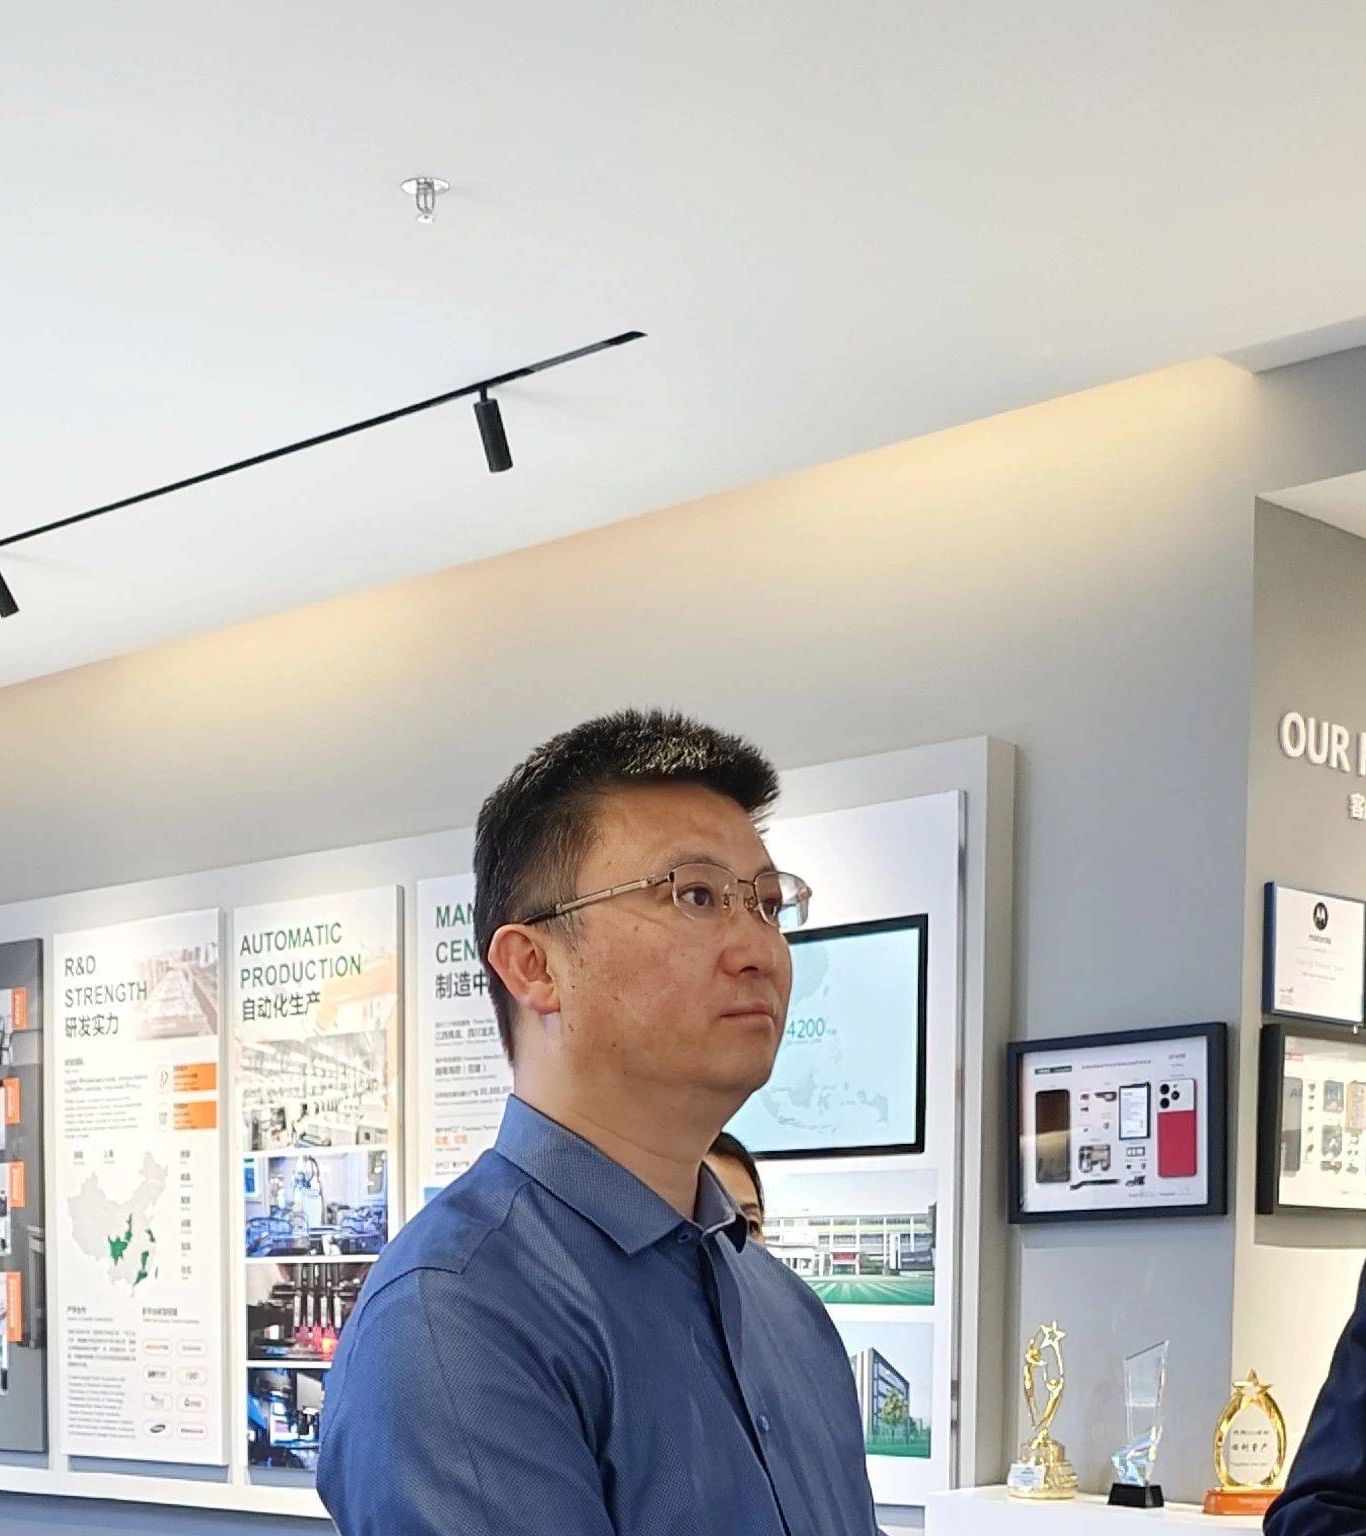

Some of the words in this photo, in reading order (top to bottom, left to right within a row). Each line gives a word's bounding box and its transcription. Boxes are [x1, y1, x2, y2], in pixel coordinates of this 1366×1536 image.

[1280, 711, 1351, 772] OUR
[240, 922, 342, 956] AUTOMATIC
[65, 955, 96, 977] R&D
[240, 954, 361, 989] PRODUCTION
[65, 981, 148, 1008] STRENGTH
[435, 969, 490, 999] 制造中
[242, 991, 321, 1021] 自动化生产
[65, 1012, 119, 1038] 研发实力
[787, 1017, 825, 1038] 4200
